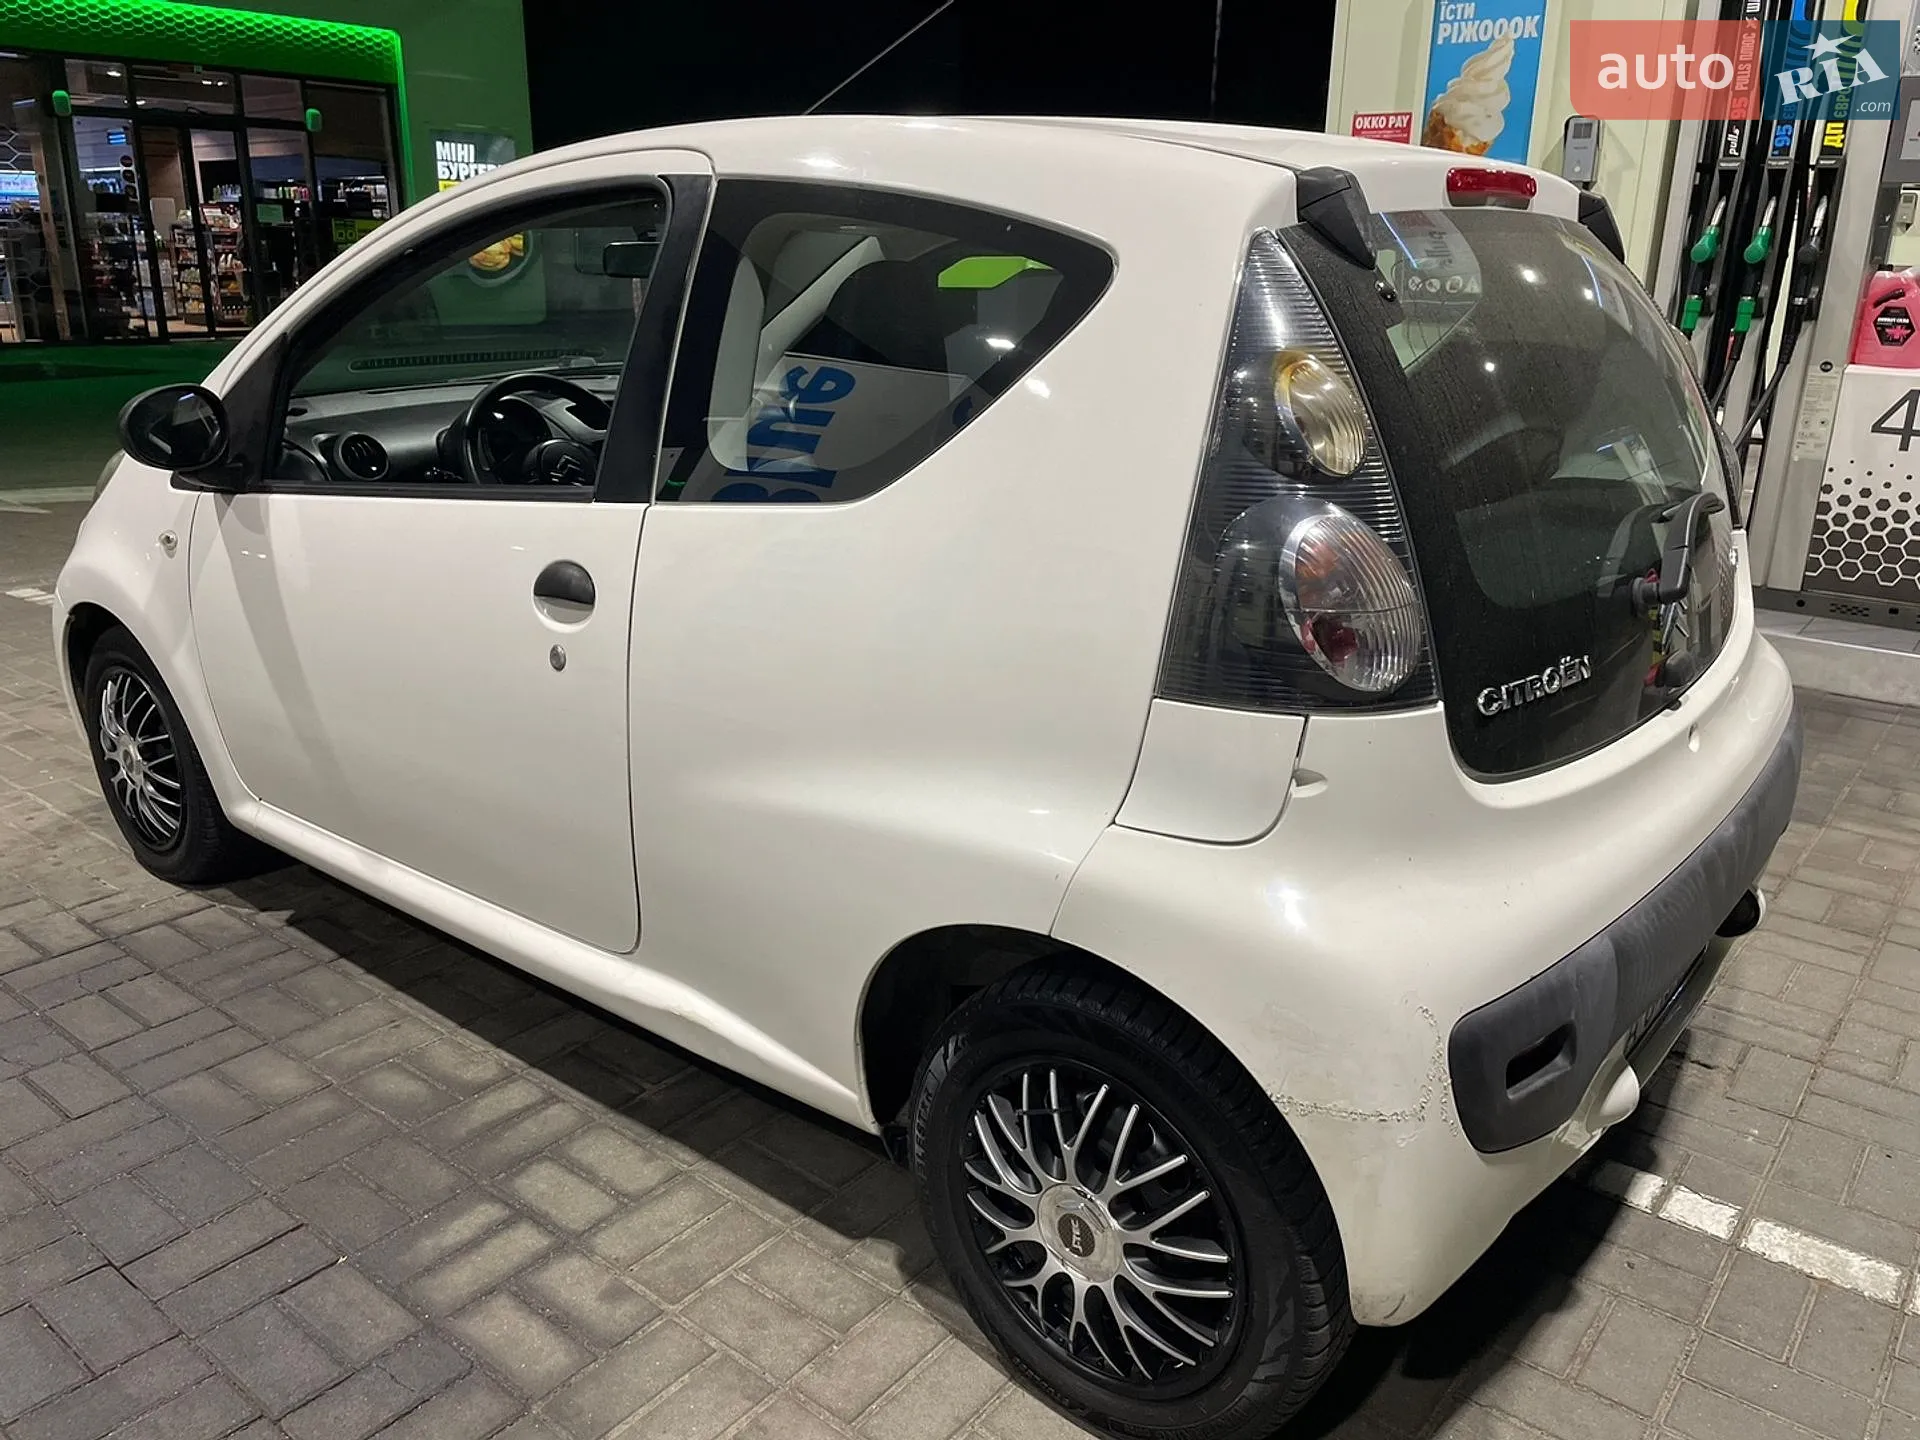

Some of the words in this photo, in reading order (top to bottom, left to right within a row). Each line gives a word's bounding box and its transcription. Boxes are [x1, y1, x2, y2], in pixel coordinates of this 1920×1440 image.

[1440, 0, 1475, 21] ЇСТИ
[1437, 15, 1541, 45] РІЖОООК
[1355, 116, 1387, 130] OKKO
[1388, 114, 1410, 129] PAY
[1823, 122, 1846, 149] ДП
[435, 140, 475, 163] МІНІ
[437, 160, 502, 181] БУРГЕ
[1870, 388, 1920, 452] 4
[1477, 654, 1592, 716] CITROËN
